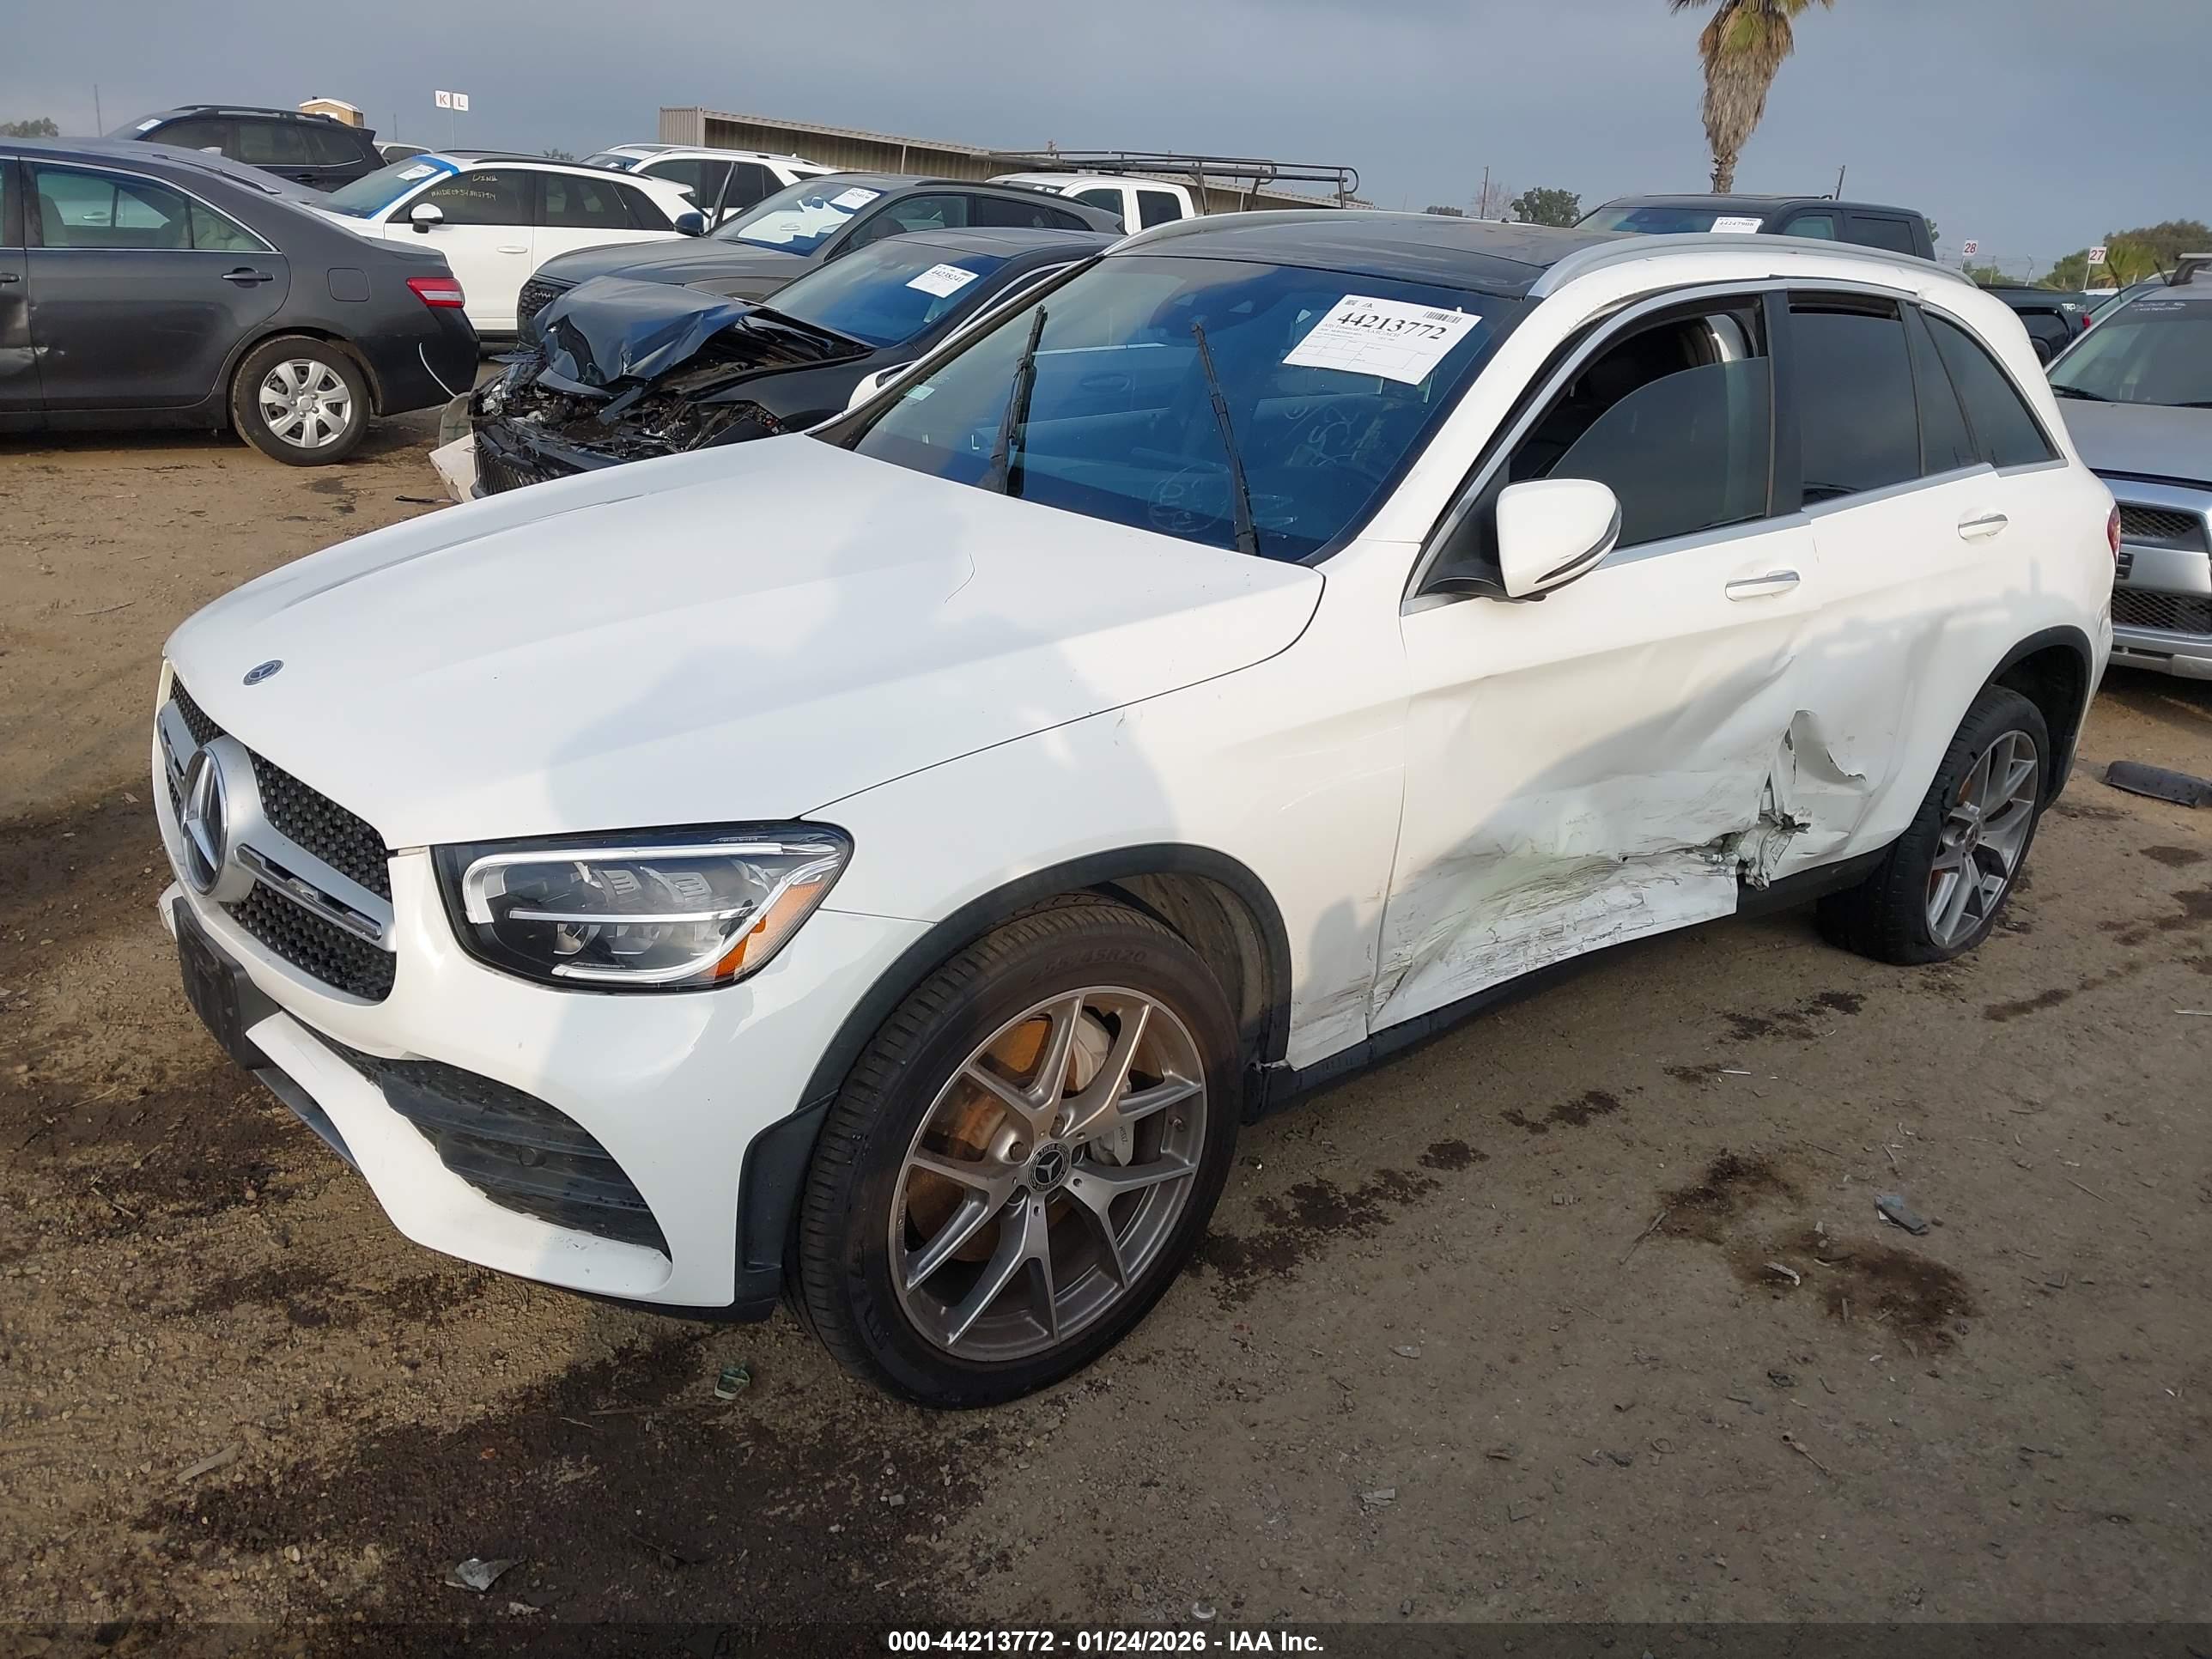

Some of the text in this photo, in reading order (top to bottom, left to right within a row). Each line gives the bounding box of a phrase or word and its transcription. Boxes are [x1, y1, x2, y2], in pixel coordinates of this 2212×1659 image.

[439, 94, 447, 105] K
[457, 96, 465, 107] L
[1964, 242, 1978, 253] 28
[2089, 250, 2105, 261] 27
[2061, 302, 2076, 312] TRD
[1336, 311, 1449, 340] 44213772
